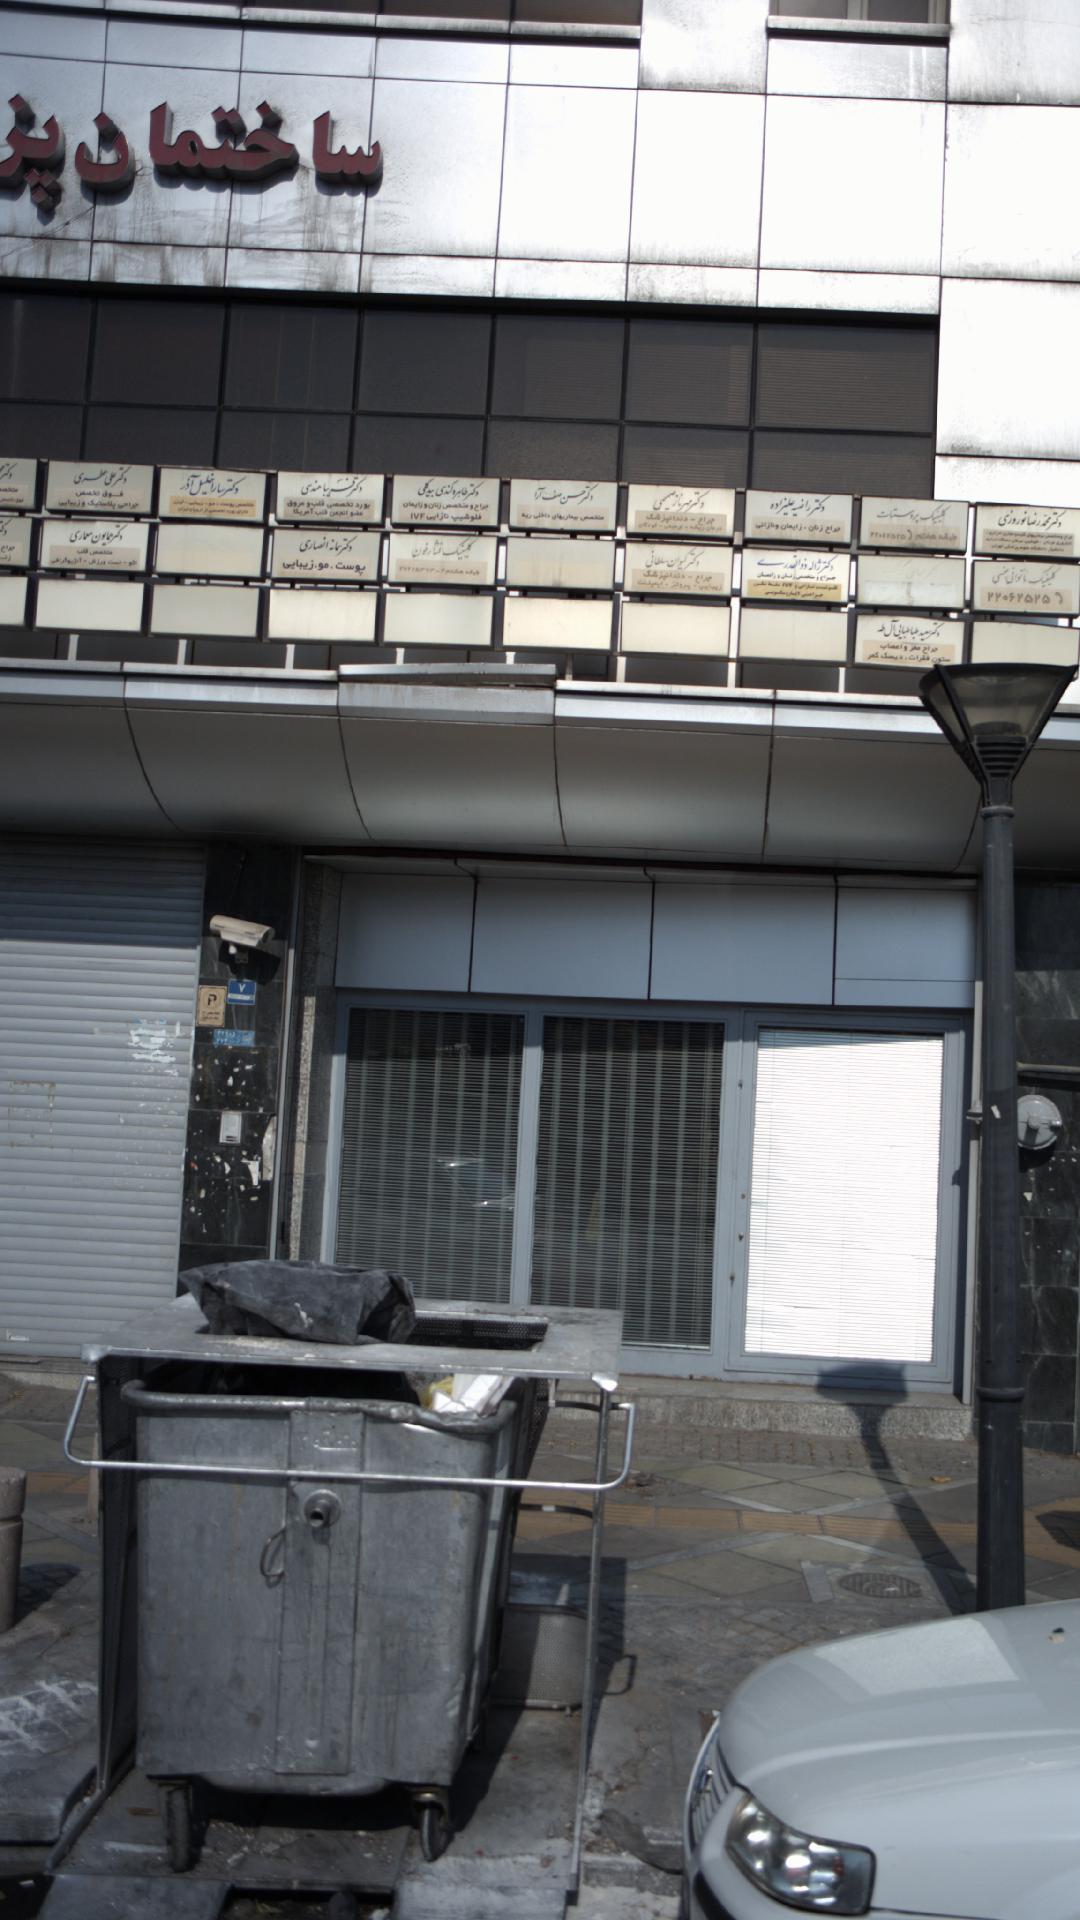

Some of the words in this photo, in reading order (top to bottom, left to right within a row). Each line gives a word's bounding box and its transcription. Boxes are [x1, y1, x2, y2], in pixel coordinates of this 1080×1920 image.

[75, 101, 383, 190] ساختمان
[111, 466, 132, 487] دکتر
[220, 476, 247, 497] دکتر
[346, 476, 367, 498] دکتر
[463, 481, 485, 501] دکتر
[75, 489, 100, 498] تخصص
[102, 490, 124, 498] فوق
[578, 483, 599, 504] دکتر
[87, 500, 116, 510] پلاستیک
[327, 501, 354, 509] تخصصی
[684, 488, 712, 512] دکتر
[117, 502, 139, 510] جراحی
[428, 502, 441, 510] زنان
[474, 504, 489, 512] جراح
[808, 495, 832, 517] دکتر
[451, 513, 482, 522] فلوشیپ
[1044, 510, 1067, 531] دکتر
[107, 523, 129, 544] دکتر
[825, 525, 841, 534] جراح
[76, 547, 89, 555] قلب
[336, 536, 358, 557] دکتر
[282, 559, 314, 571] زیبایی
[318, 563, 329, 572] مو
[335, 562, 366, 576] پوست
[818, 553, 839, 574] دکتر
[923, 622, 945, 640] دکتر
[922, 646, 938, 654] جراح
[868, 652, 879, 660] کمر
[909, 654, 930, 662] فقرات
[931, 656, 951, 664] ستون
